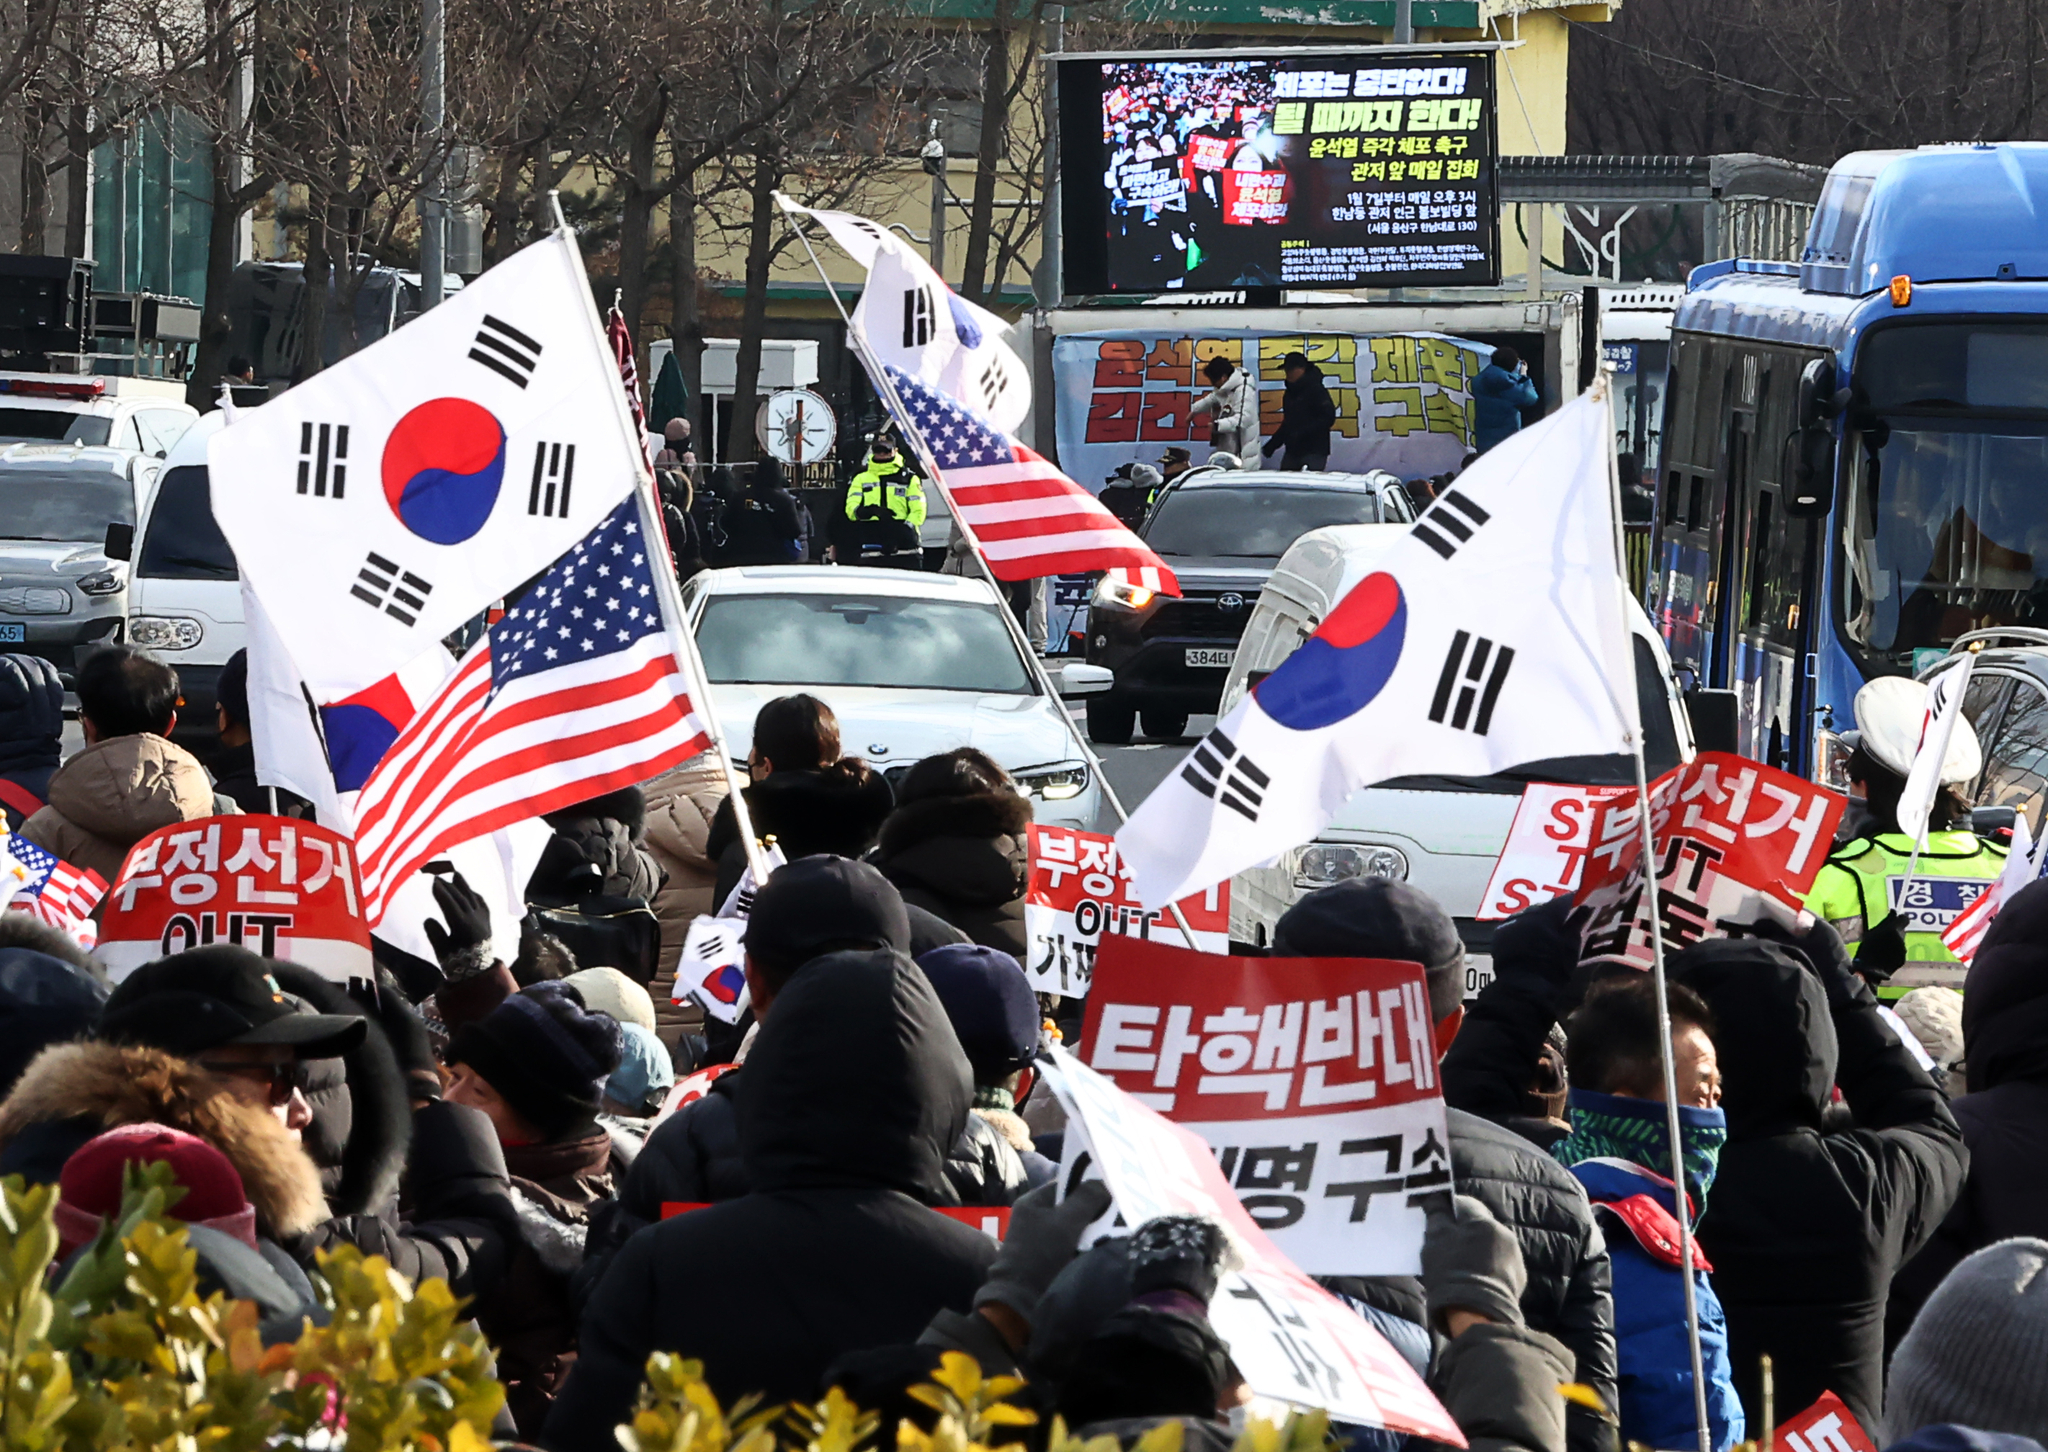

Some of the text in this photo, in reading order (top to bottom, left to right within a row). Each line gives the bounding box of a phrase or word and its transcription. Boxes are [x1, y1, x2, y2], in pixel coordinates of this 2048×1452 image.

[1272, 67, 1467, 98] 체포는 중단없다!
[1273, 98, 1482, 134] 될 때까지 한다!
[1309, 135, 1468, 158] 윤석열 즉각 체포 촉구
[1351, 159, 1479, 181] 관저 앞 매일 집회
[1366, 191, 1406, 205] 7일부터
[1408, 191, 1431, 205] 매일
[1433, 190, 1456, 204] 오후
[1458, 190, 1476, 203] 3시
[1332, 206, 1366, 221] 한남동
[1368, 206, 1391, 220] 관저
[1393, 206, 1415, 220] 인근
[1465, 204, 1477, 218] 앞
[1367, 220, 1478, 235] (서울 용산구 한남대로 130)
[113, 823, 359, 918] 부정선거
[1091, 980, 1435, 1113] 탄핵반대
